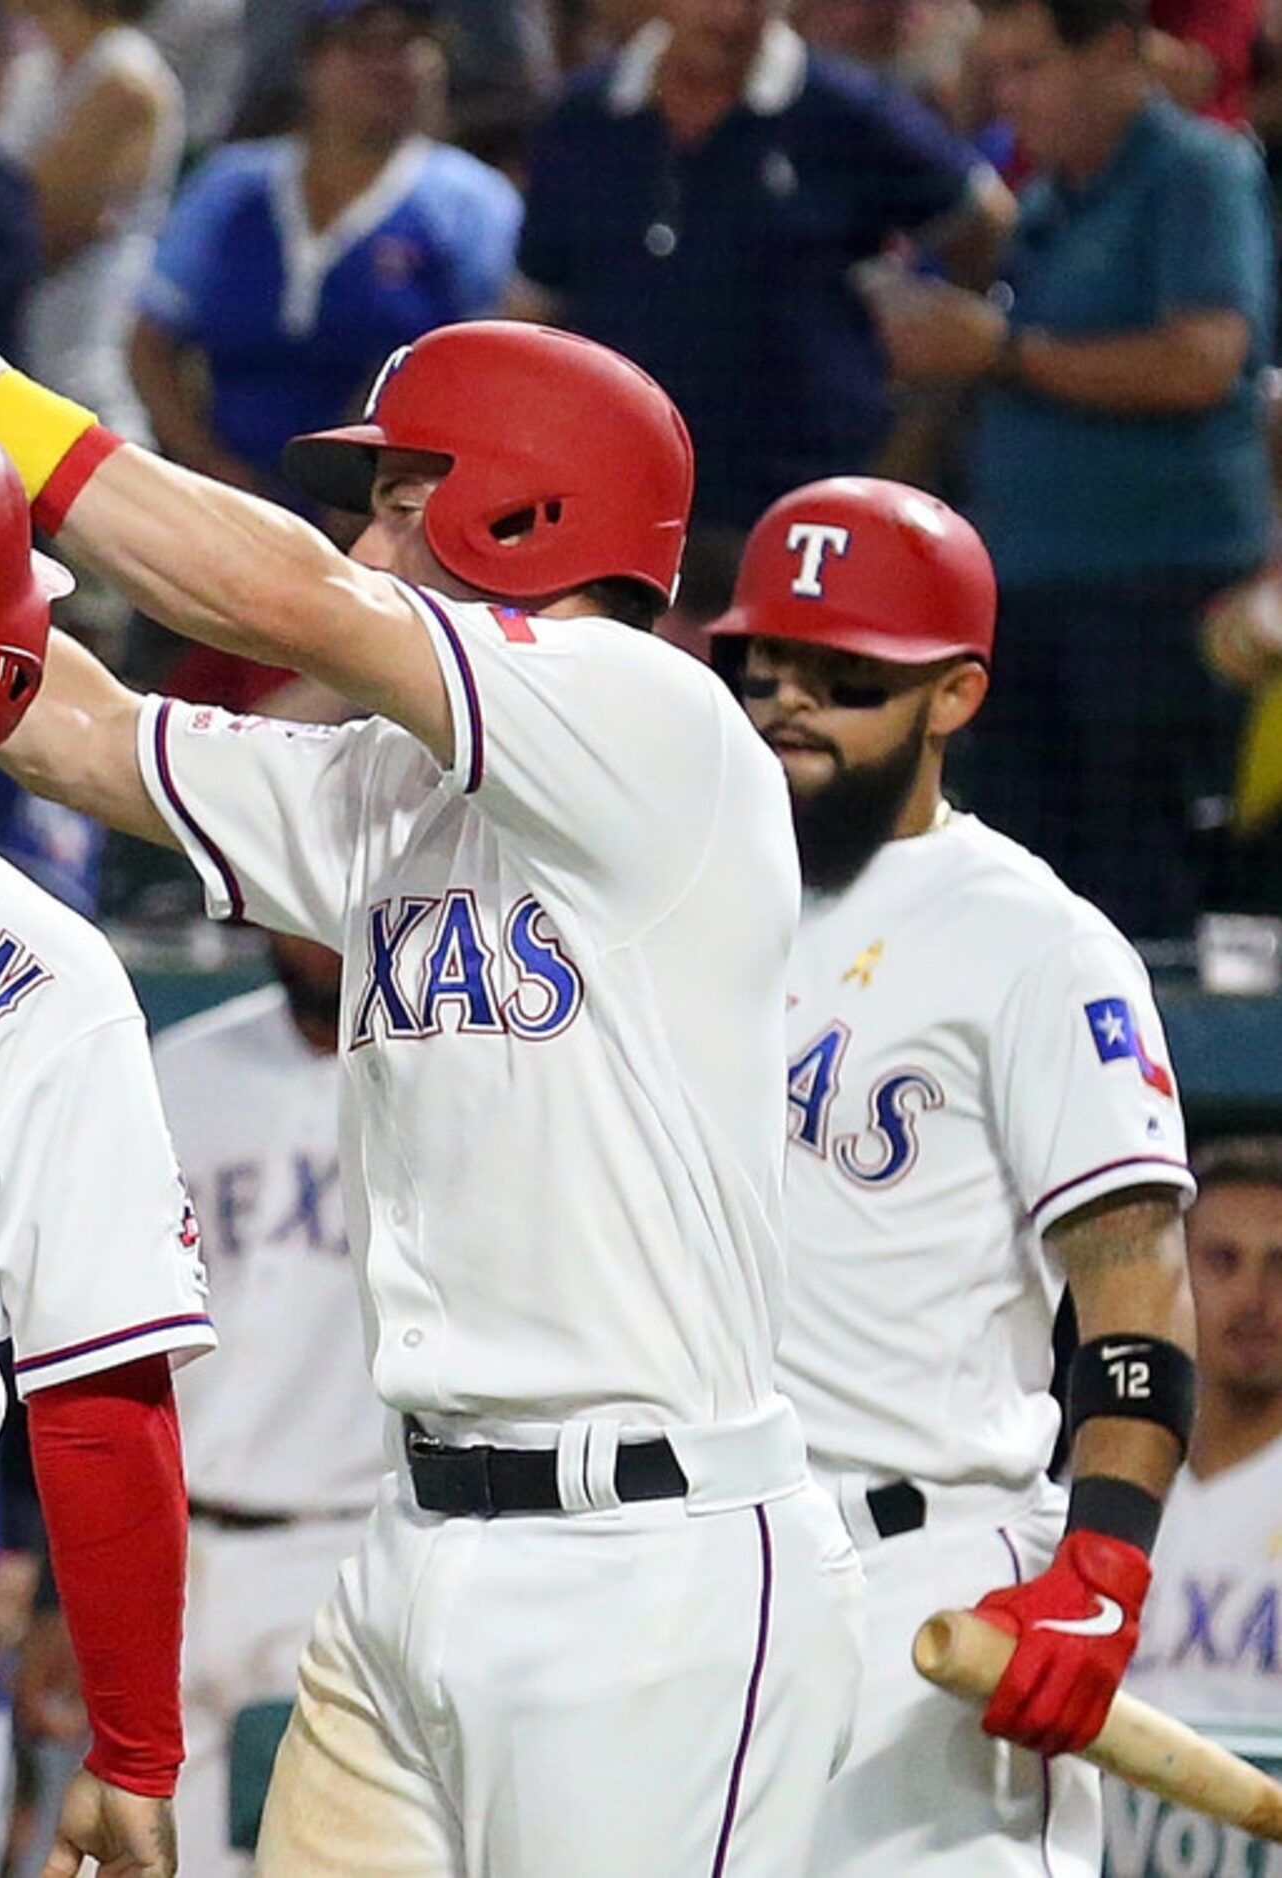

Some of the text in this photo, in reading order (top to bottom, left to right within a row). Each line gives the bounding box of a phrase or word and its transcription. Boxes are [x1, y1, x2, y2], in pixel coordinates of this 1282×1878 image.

[786, 521, 852, 600] T
[349, 887, 585, 1053] XAS
[786, 1015, 946, 1193] AS
[1107, 1360, 1151, 1398] 12
[1128, 1578, 1282, 1676] XA
